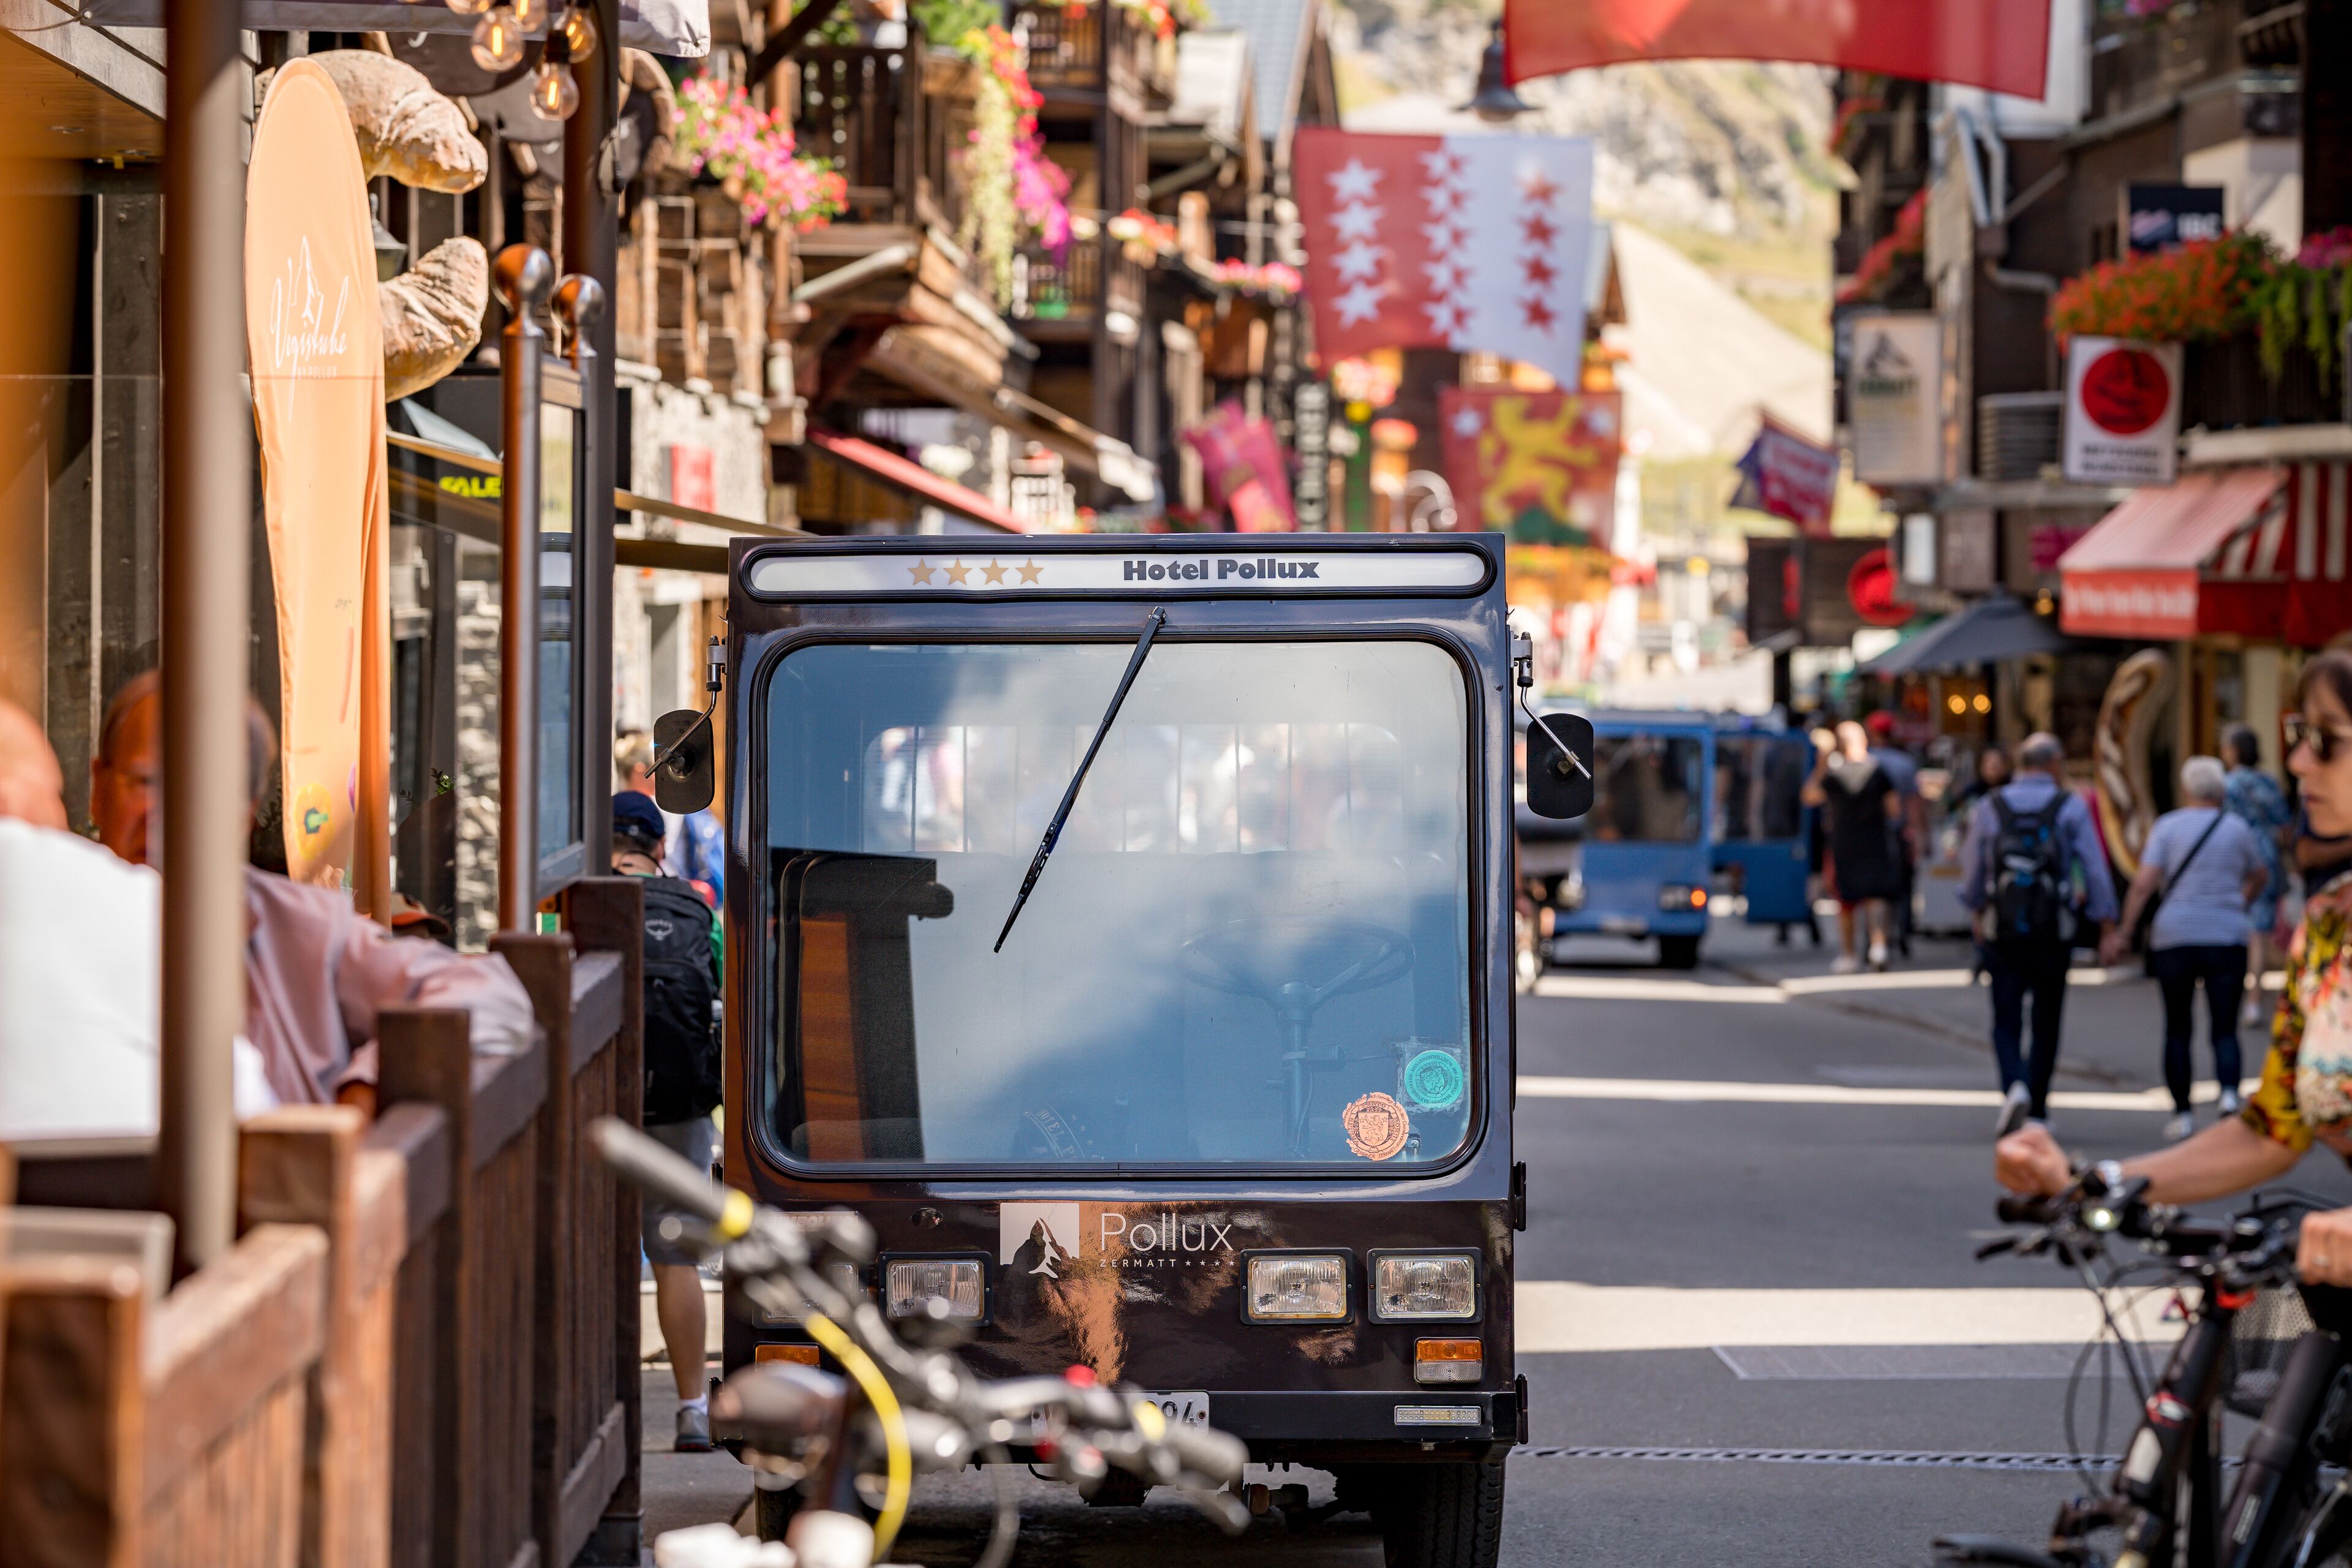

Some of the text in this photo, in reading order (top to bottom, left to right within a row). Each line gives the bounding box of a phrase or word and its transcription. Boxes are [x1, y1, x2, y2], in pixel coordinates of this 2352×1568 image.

[1123, 558, 1320, 580] Hotel Pollux
[1378, 1148, 1396, 1158] ZERMATT
[1101, 1212, 1234, 1252] Pollux
[1099, 1259, 1177, 1268] ZERMATT
